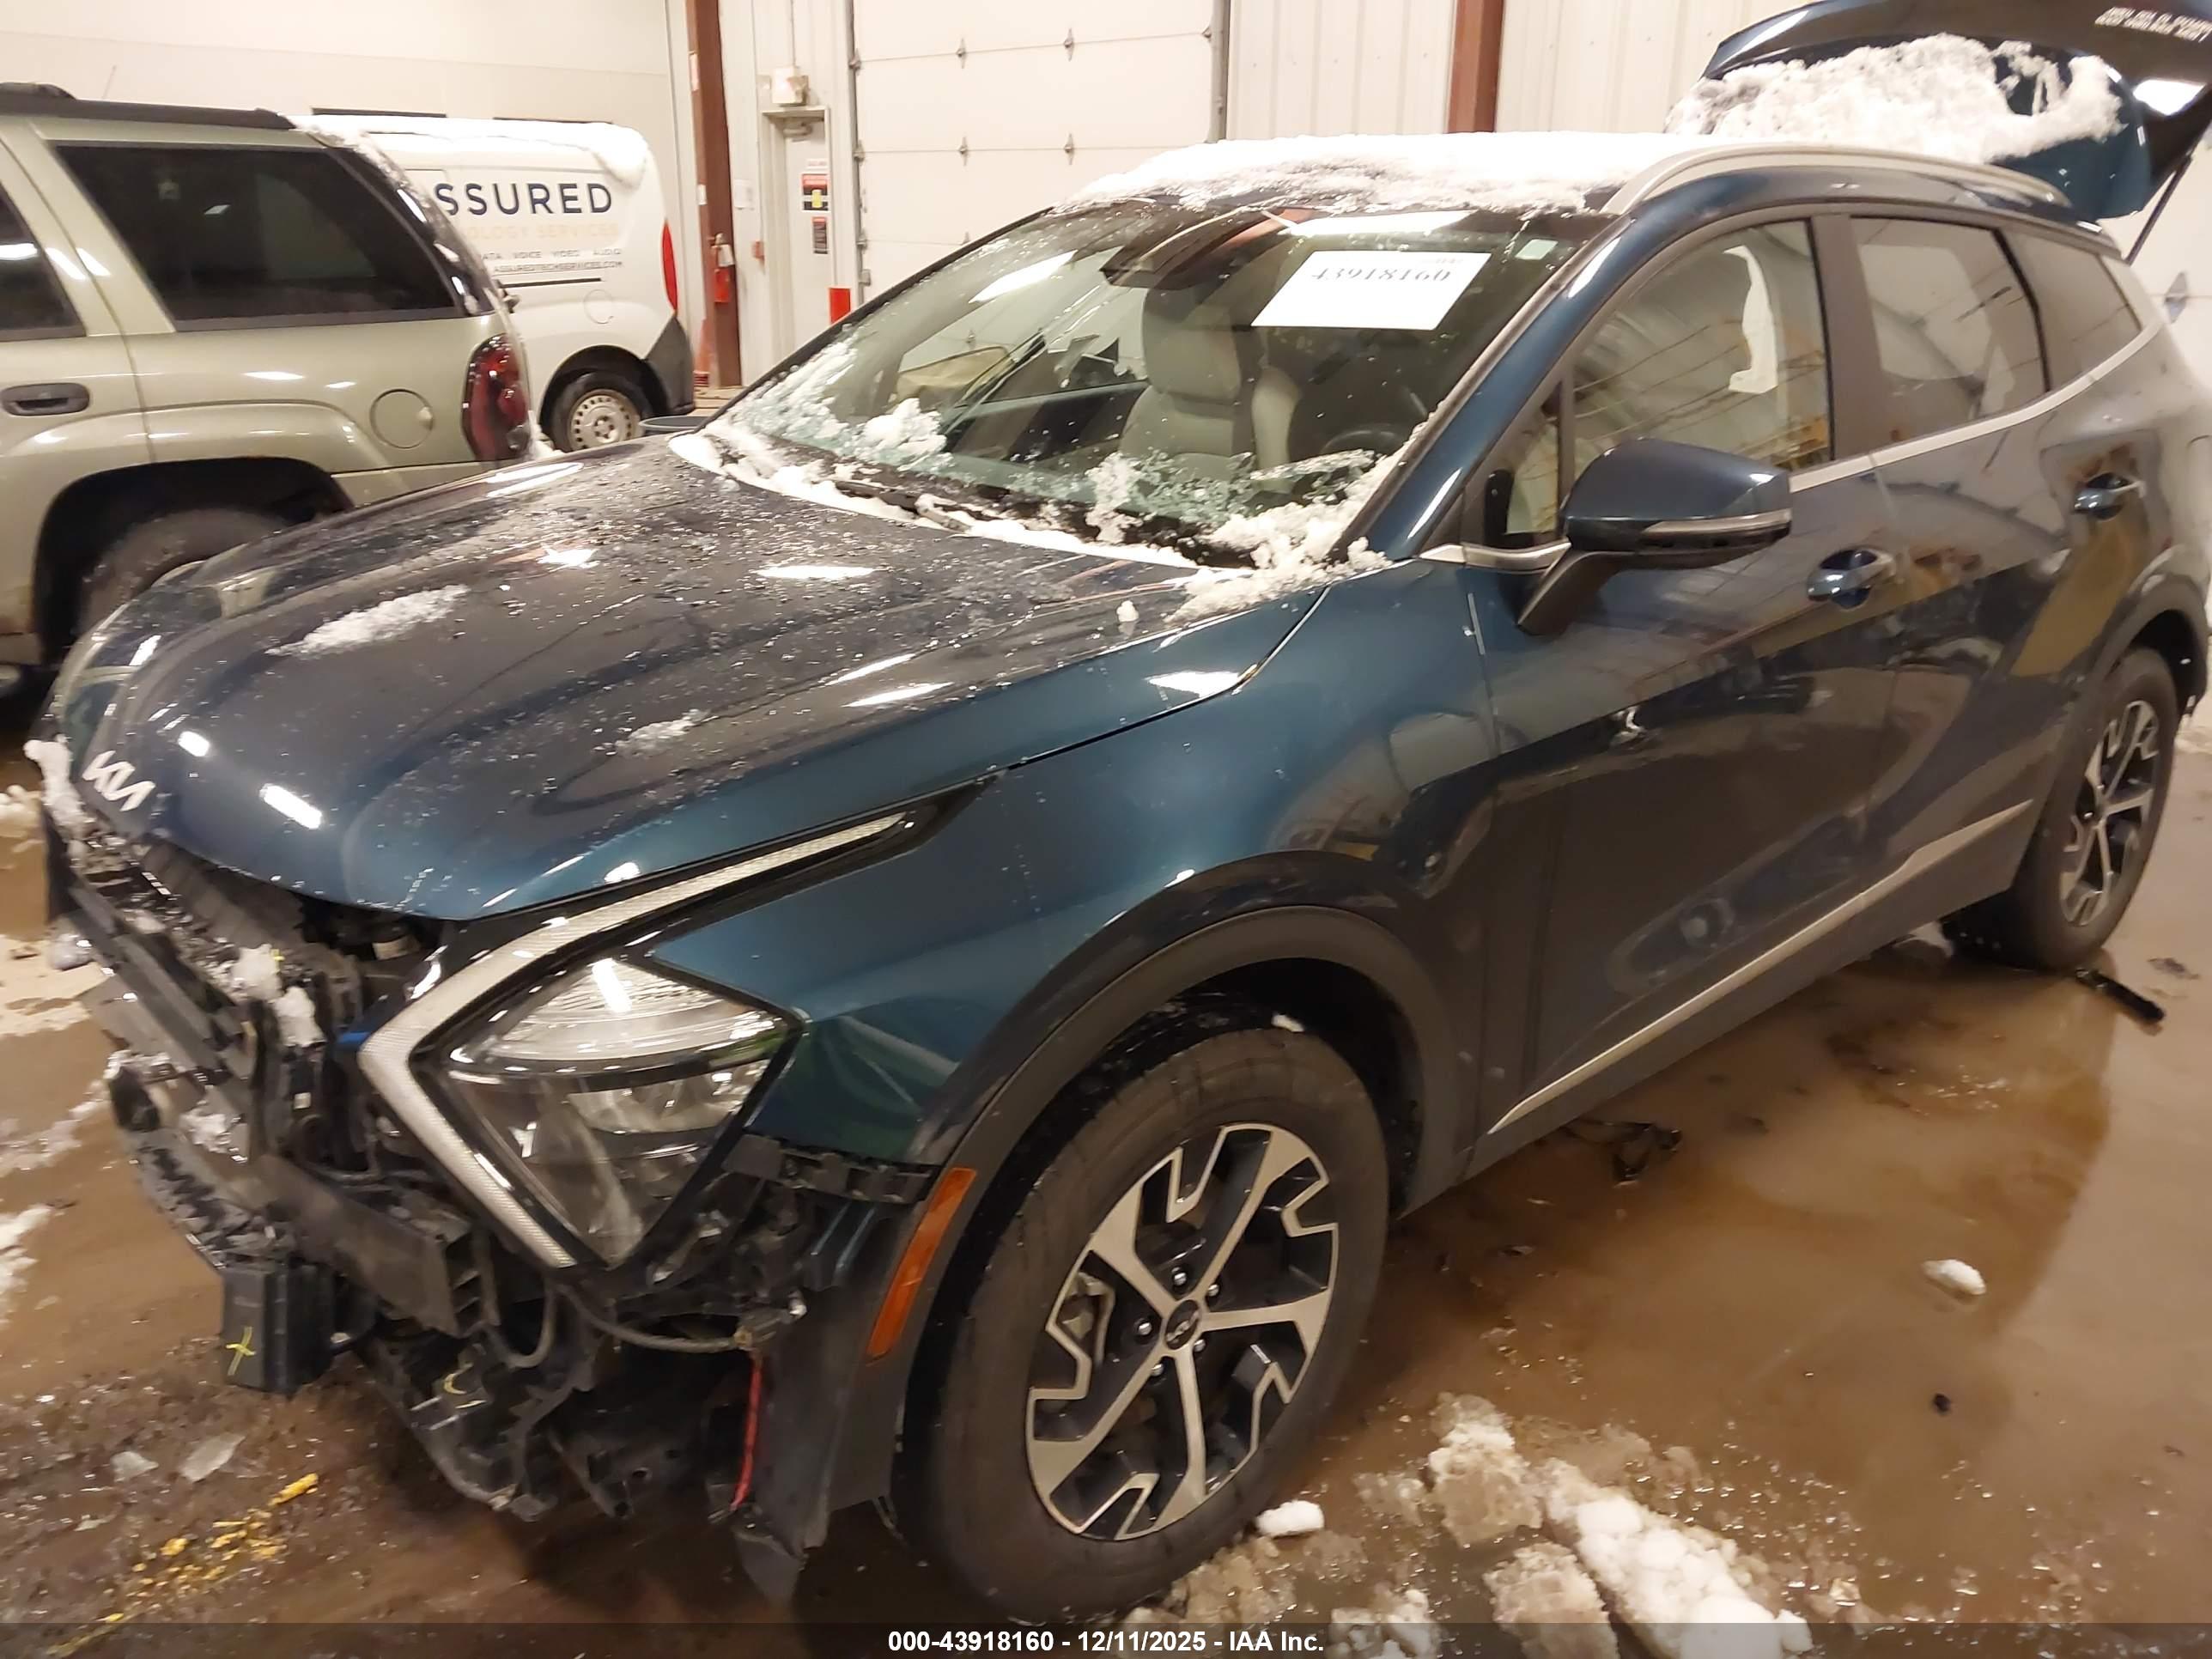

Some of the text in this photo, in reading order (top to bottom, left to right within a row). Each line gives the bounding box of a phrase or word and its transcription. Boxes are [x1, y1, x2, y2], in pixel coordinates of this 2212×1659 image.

[434, 182, 612, 216] SSURED
[1310, 267, 1452, 281] 43918160
[82, 750, 156, 811] KIA
